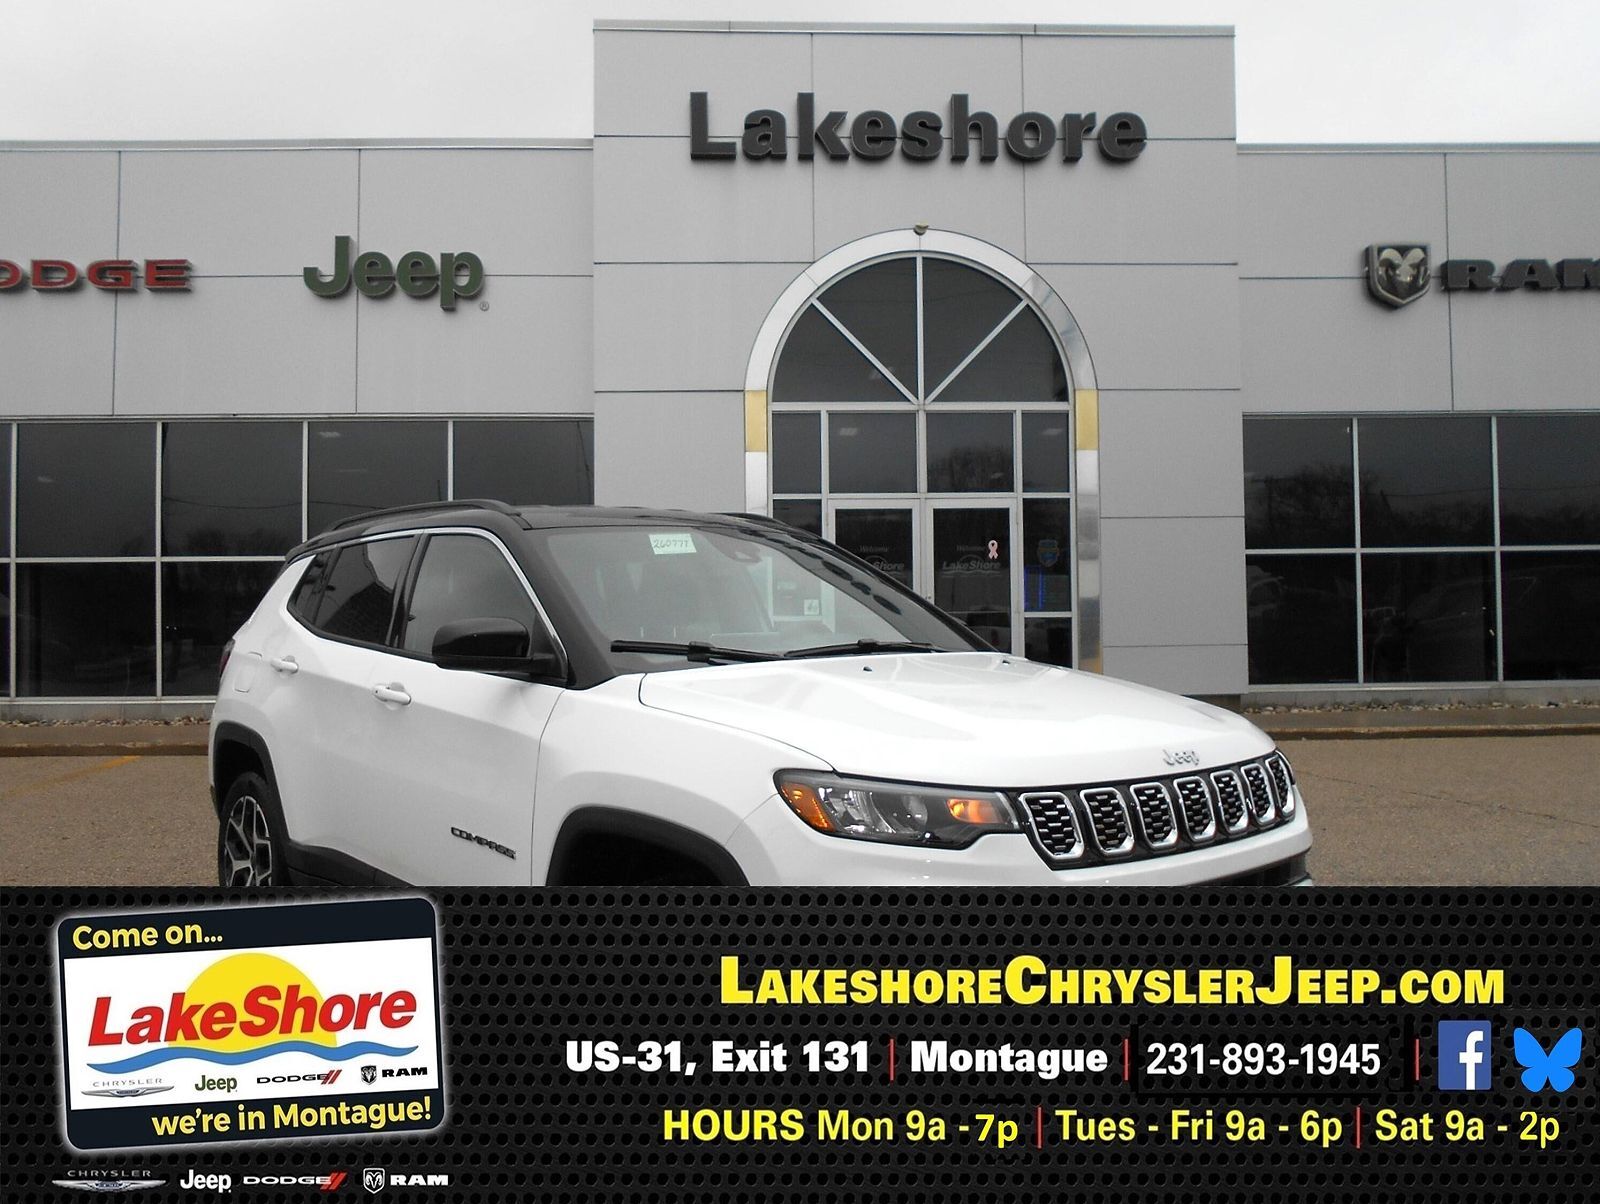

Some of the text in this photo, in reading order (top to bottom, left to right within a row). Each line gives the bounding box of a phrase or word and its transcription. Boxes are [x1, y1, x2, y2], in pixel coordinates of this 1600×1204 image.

[690, 91, 1147, 162] Lakeshore
[303, 235, 485, 312] Jeep
[450, 826, 517, 861] COMPASS
